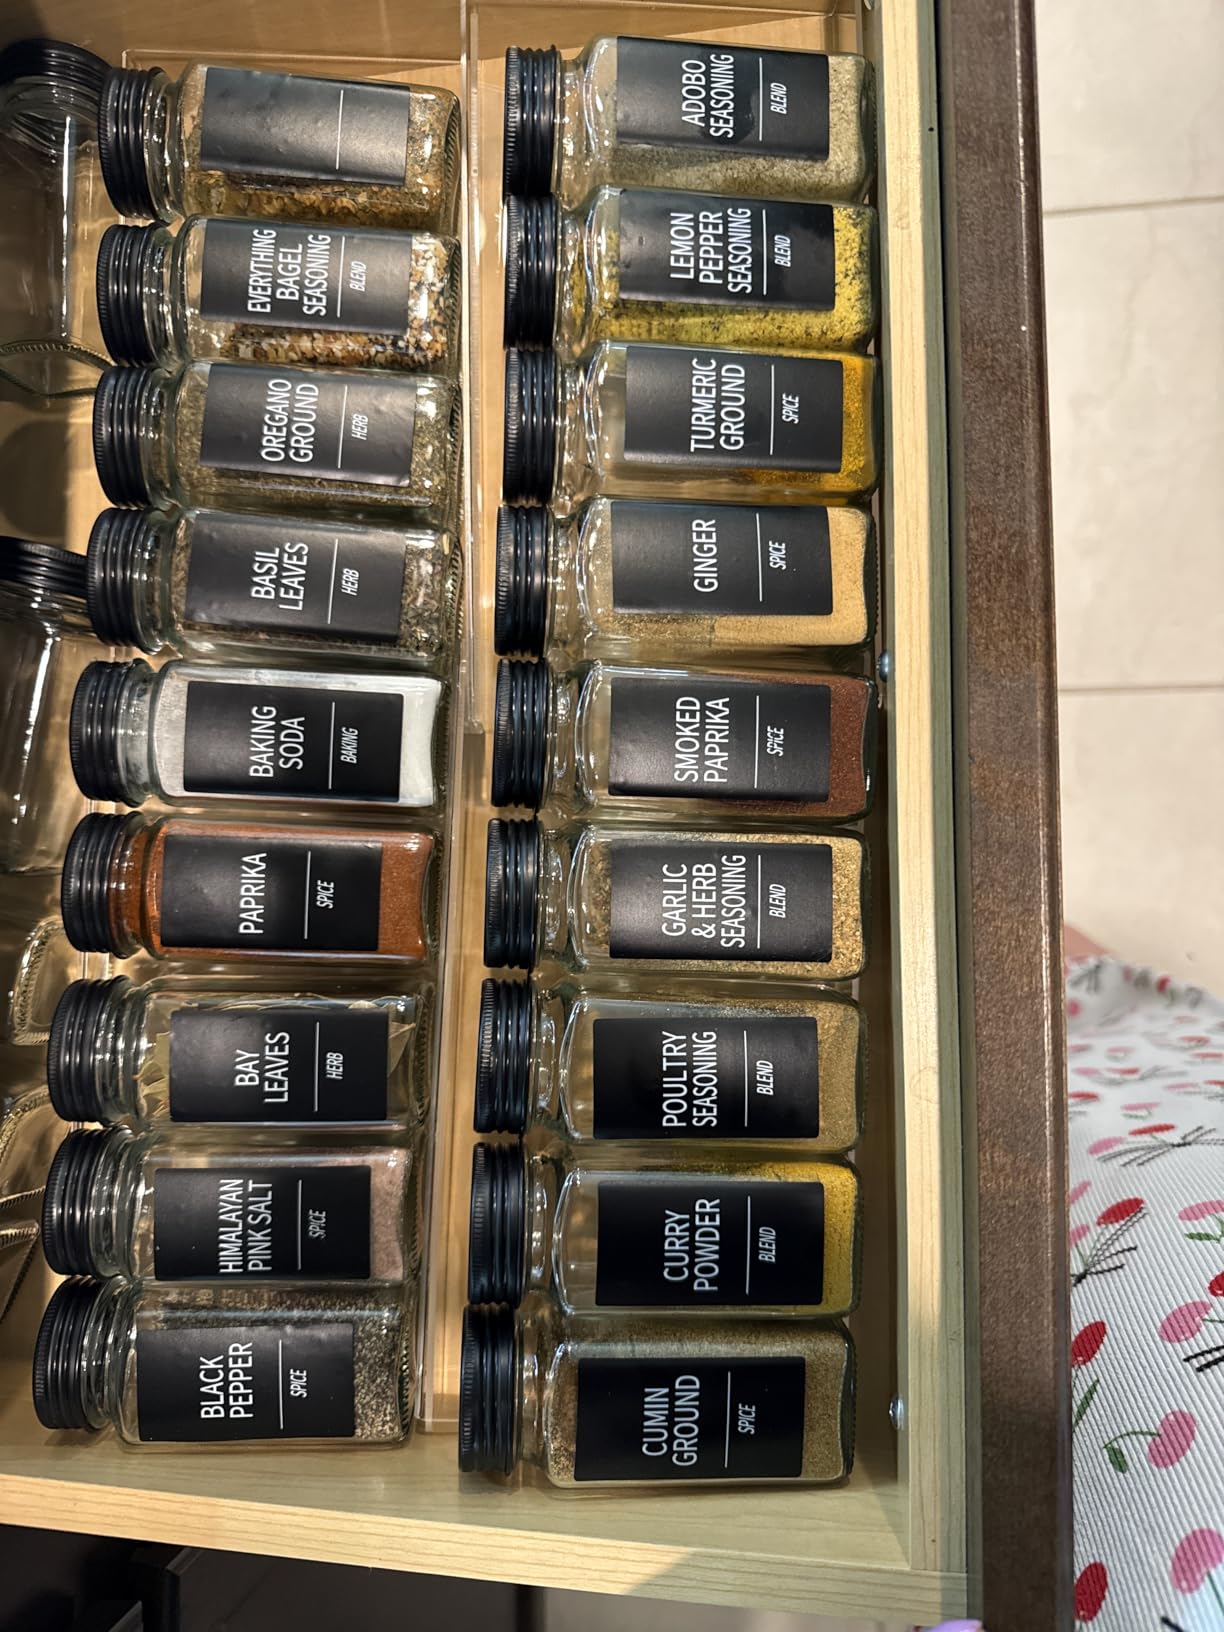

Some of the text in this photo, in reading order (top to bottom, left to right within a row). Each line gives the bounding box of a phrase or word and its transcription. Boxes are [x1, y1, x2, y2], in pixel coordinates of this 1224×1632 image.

[681, 60, 706, 126] ADOBO
[710, 54, 734, 137] SEASONING
[771, 83, 786, 114] BLEND
[248, 229, 276, 312] EVERYTHING
[276, 244, 302, 300] BAGEL
[303, 235, 331, 315] SEASONING
[350, 261, 366, 291] BLEND
[670, 213, 694, 278] LEMON
[699, 211, 723, 283] PEPPER
[727, 208, 752, 293] SEASONING
[775, 235, 791, 267] BLEND
[261, 379, 292, 461] OREGANO
[289, 383, 320, 462] GROUND
[351, 413, 368, 440] HERB
[691, 358, 716, 452] TURMERIC
[720, 364, 745, 450] GROUND
[782, 393, 799, 423] SPICE
[251, 548, 279, 599] BASIL
[279, 542, 308, 610] LEAVES
[342, 568, 359, 595] HERB
[692, 520, 718, 592] GINGER
[769, 541, 786, 570] SPICE
[249, 707, 276, 777] BAKING
[279, 717, 304, 769] SODA
[341, 727, 358, 763] BAKING
[672, 697, 700, 782] SMOKED
[704, 698, 729, 782] PAPRIKA
[767, 726, 784, 756] SPICE
[239, 853, 266, 933] PAPRIKA
[317, 880, 334, 908] SPICE
[662, 864, 687, 936] GARLIC
[691, 863, 717, 938] & HERB
[721, 856, 746, 947] SEASONING
[769, 884, 786, 918] BLEND
[235, 1049, 259, 1085] BAY
[264, 1032, 289, 1102] LEAVES
[326, 1052, 343, 1079] HERB
[662, 1031, 687, 1126] POULTRY
[692, 1032, 717, 1126] SEASONING
[756, 1060, 773, 1095] BLEND
[219, 1179, 243, 1272] HIMALAYAN
[247, 1179, 272, 1270] PINK SALT
[309, 1209, 326, 1238] SPICE
[663, 1210, 689, 1280] CURRY
[694, 1199, 720, 1290] POWDER
[759, 1227, 776, 1262] BLEND
[199, 1355, 224, 1418] BLACK
[228, 1343, 253, 1418] PEPPER
[290, 1369, 307, 1397] SPICE
[642, 1388, 669, 1456] CUMIN
[672, 1375, 699, 1466] GROUND
[738, 1403, 755, 1434] SPICE
